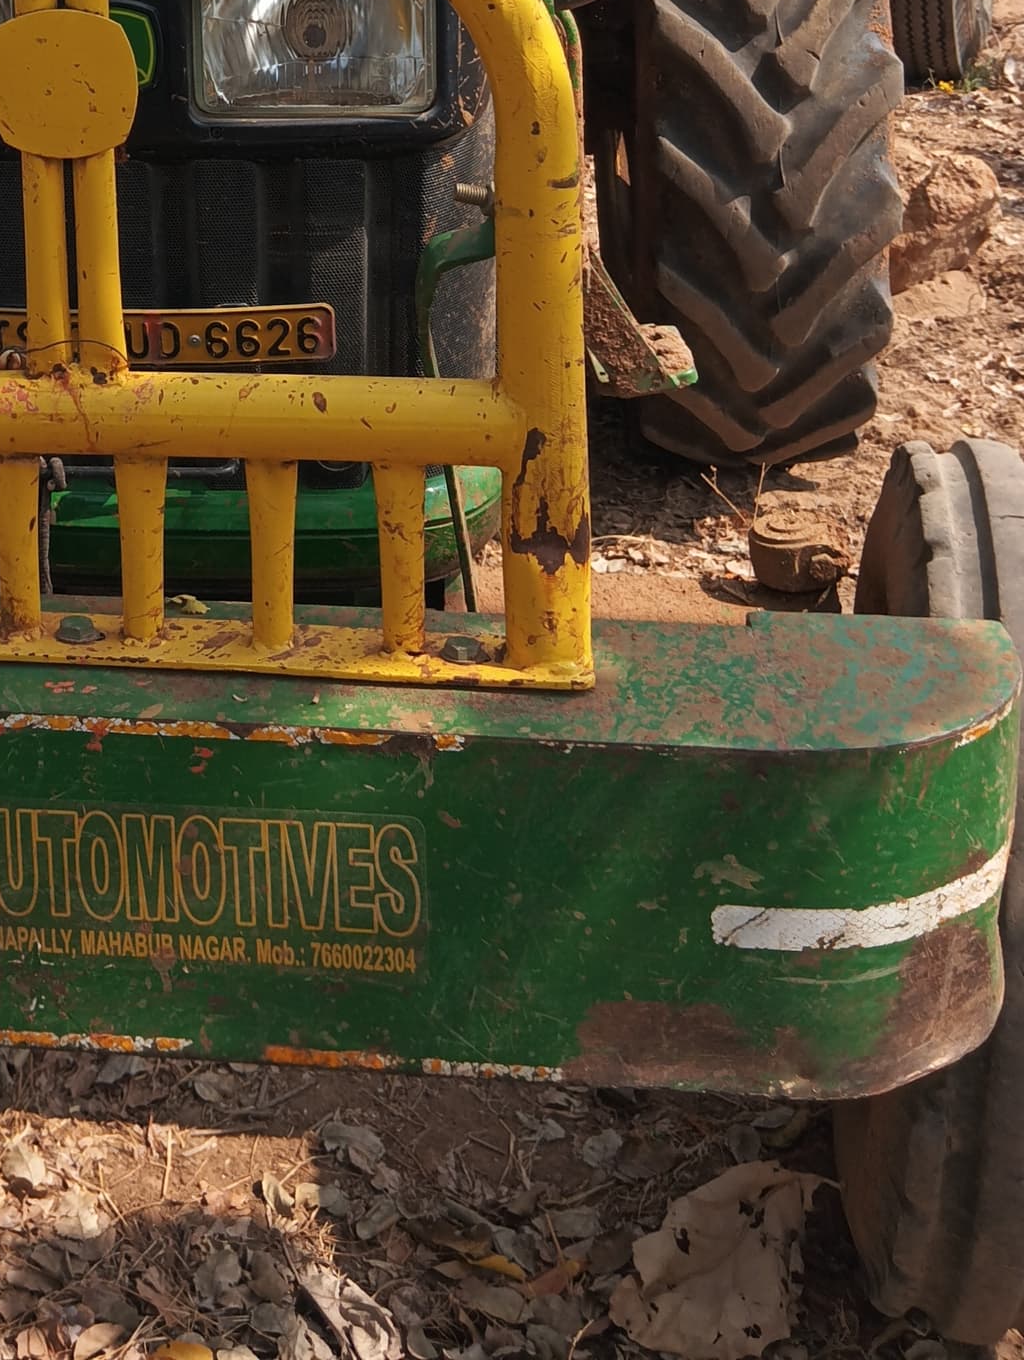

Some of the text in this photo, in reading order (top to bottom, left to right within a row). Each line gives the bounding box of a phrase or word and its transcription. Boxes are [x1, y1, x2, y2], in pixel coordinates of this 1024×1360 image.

[205, 316, 322, 358] 6626
[80, 929, 175, 959] MAHABUB
[311, 942, 417, 974] 7660022304
